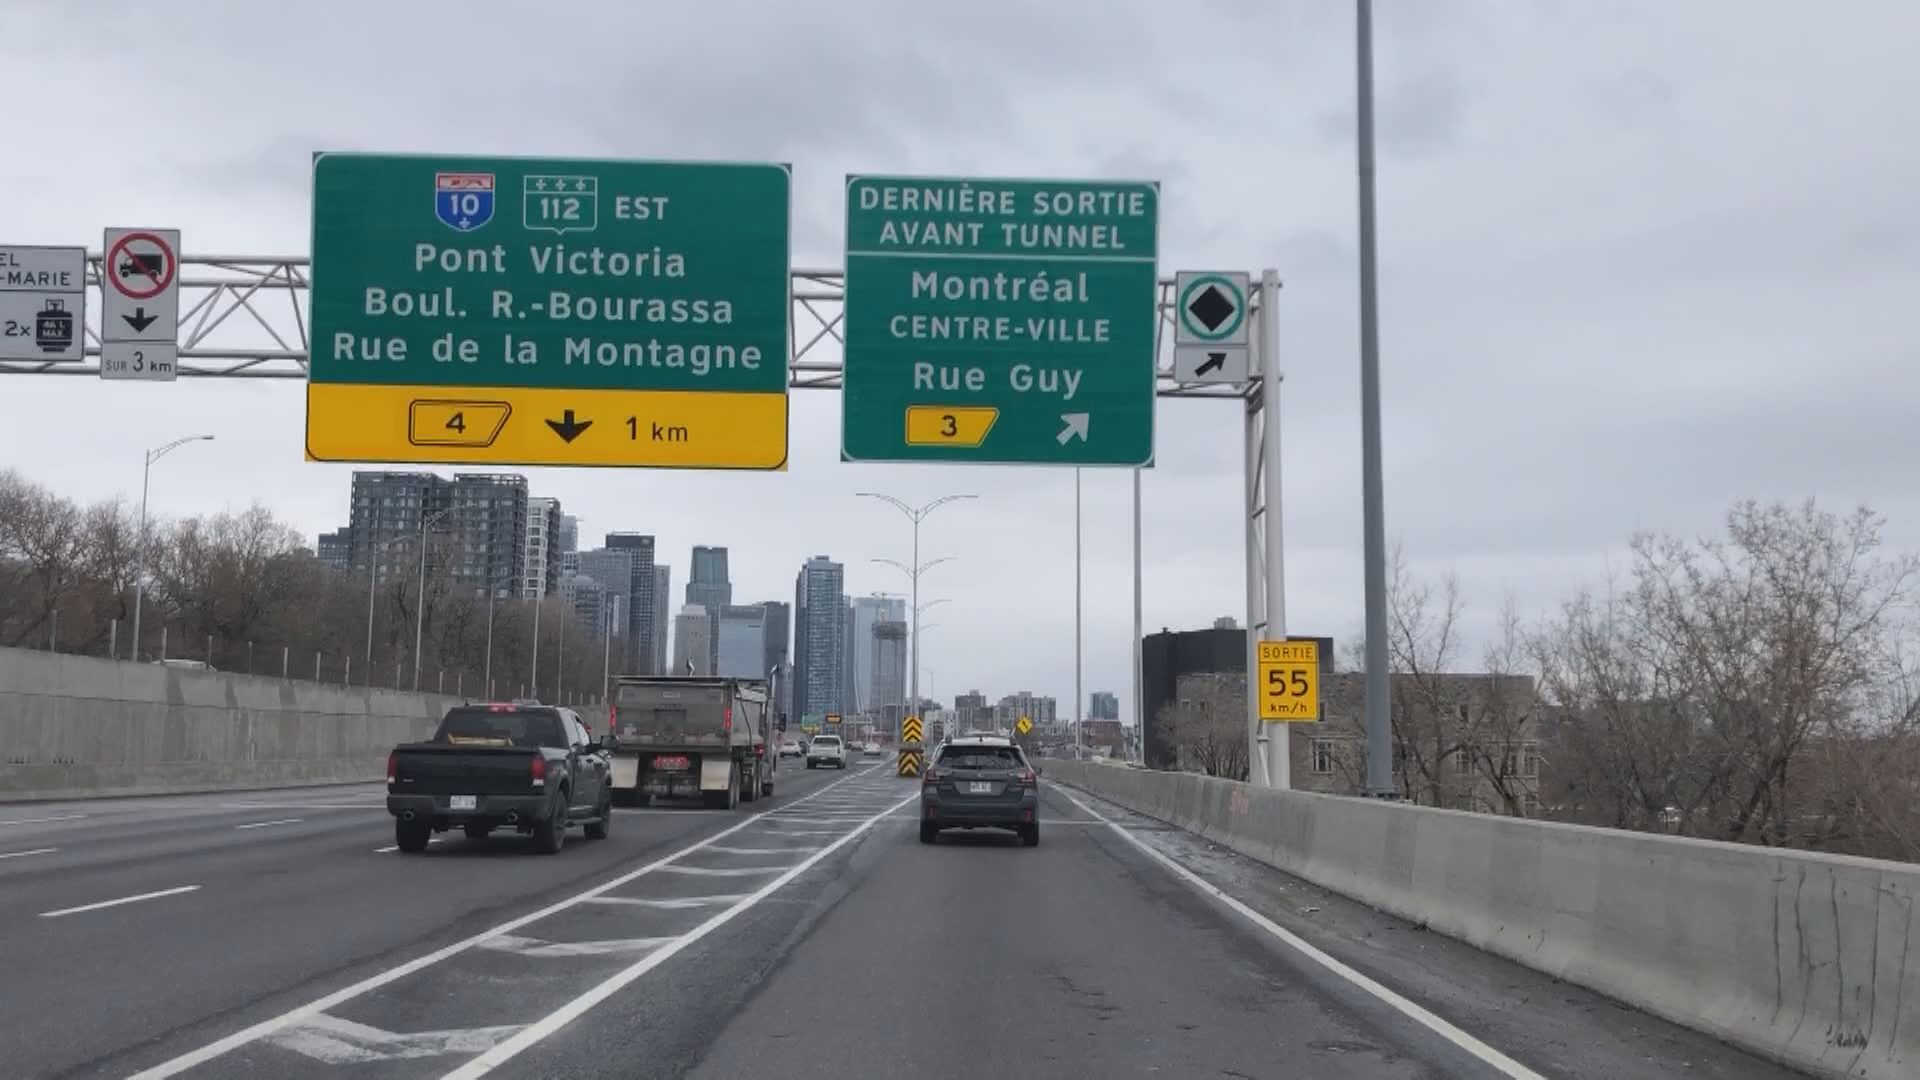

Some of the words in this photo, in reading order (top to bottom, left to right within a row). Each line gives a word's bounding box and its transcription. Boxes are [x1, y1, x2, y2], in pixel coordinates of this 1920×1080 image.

[451, 194, 480, 215] 10
[541, 197, 580, 220] 112
[615, 196, 669, 220] EST
[861, 182, 1015, 214] DERNIÈRE
[1034, 192, 1145, 216] SORTIE
[880, 221, 984, 246] AVANT
[1002, 224, 1125, 248] TUNNEL
[415, 243, 506, 273] Pont
[530, 244, 686, 277] Victoria
[912, 270, 1089, 302] Montréal
[365, 287, 467, 317] Boul.
[492, 290, 733, 324] R.-Bourassa
[5, 321, 31, 336] 2x
[890, 315, 1110, 342] CENTRE-VILLE
[106, 359, 127, 371] SUR
[133, 351, 144, 372] 3
[150, 361, 172, 372] km
[334, 332, 407, 361] Rue
[432, 333, 480, 363] de
[505, 334, 538, 364] la
[565, 337, 762, 376] Montagne
[914, 362, 986, 391] Rue
[1009, 364, 1083, 400] Guy
[445, 411, 466, 434] 4
[625, 416, 638, 441] 1
[652, 422, 689, 442] km
[940, 414, 958, 437] 3
[1263, 647, 1313, 658] SORTIE
[1269, 669, 1309, 697] 55
[1270, 702, 1308, 714] km/h
